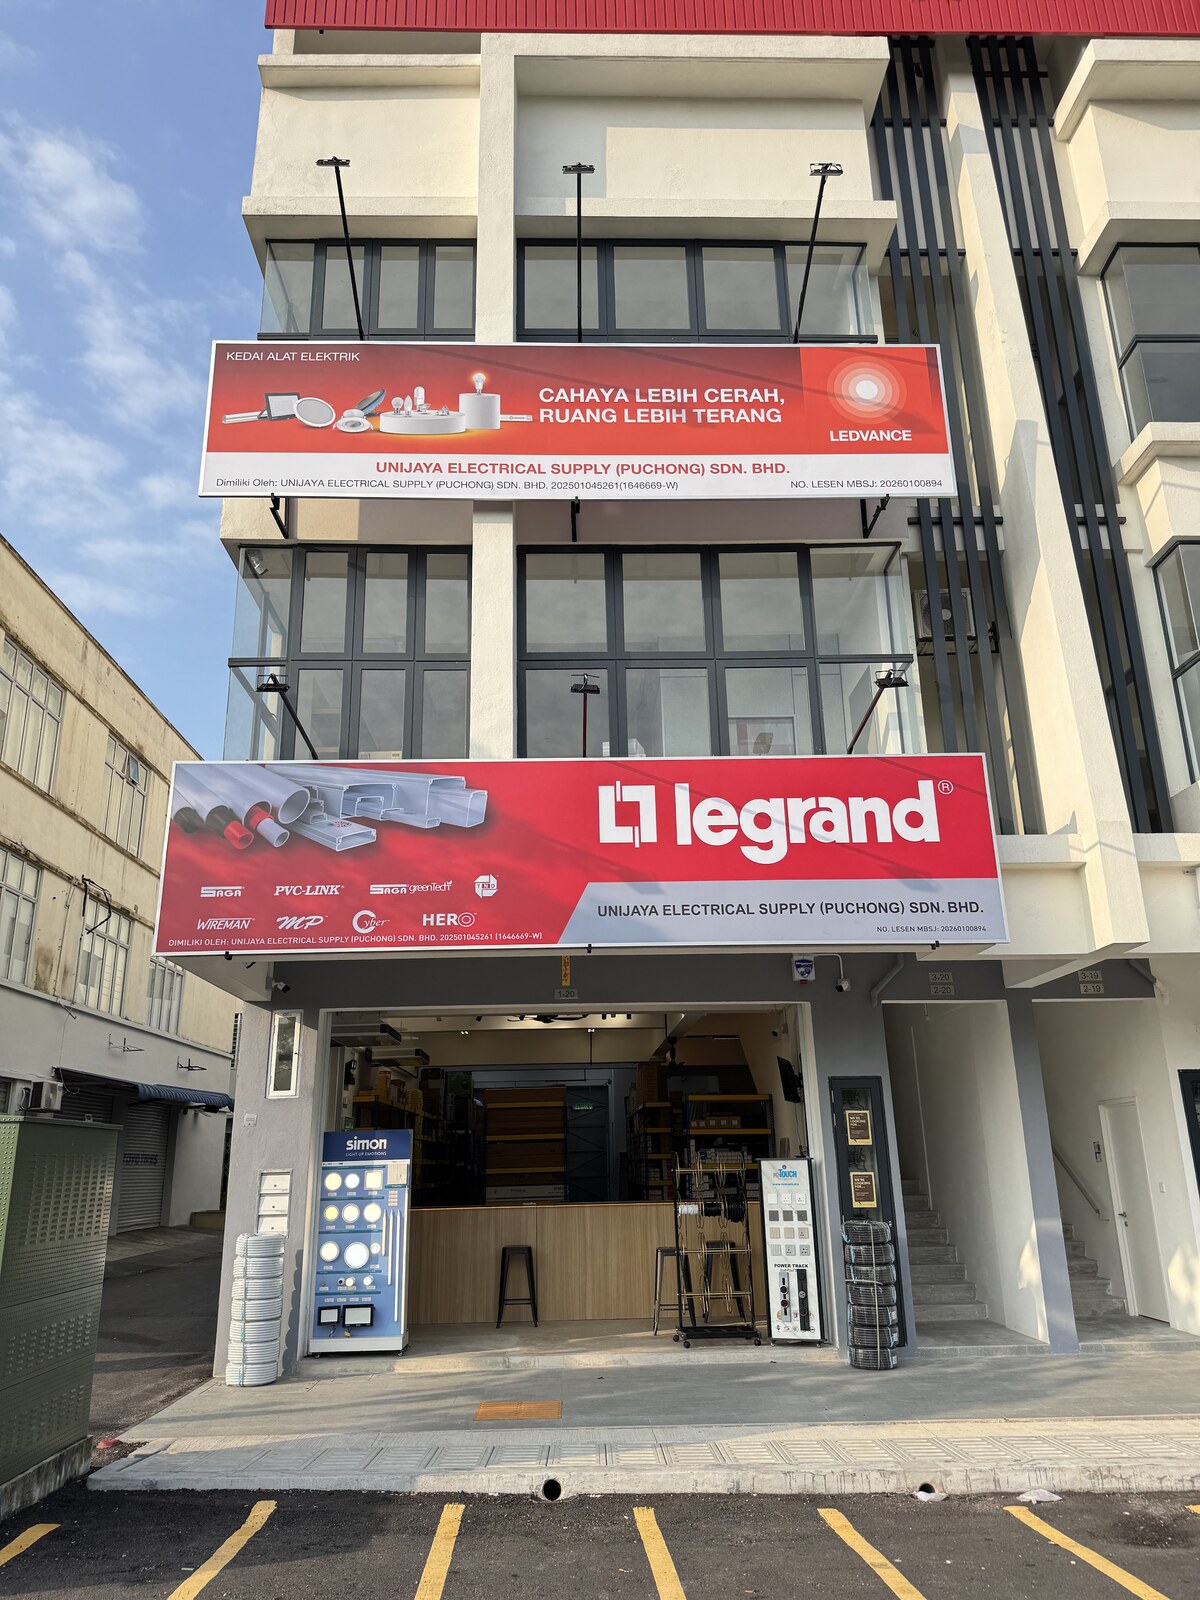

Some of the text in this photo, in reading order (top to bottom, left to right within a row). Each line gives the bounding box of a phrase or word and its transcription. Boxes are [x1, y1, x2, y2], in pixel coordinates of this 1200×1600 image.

[226, 352, 360, 361] KEDAI ALAT ELEKTRIK
[538, 388, 785, 405] CAHAYA LEBIH CERAH,
[539, 408, 782, 423] RUANG LEBIH TERANG
[829, 430, 912, 442] LEDVANCE
[376, 462, 790, 476] UNIJAYA ELECTRICAL SUPPLY (PUCHONG) SDN. BHD.
[216, 478, 679, 491] Dimiliki Oleh: UNIJAYA ELECTRICAL SUPPLY (PUCHONG) SDN. BHD. 202501045261(1646669-W)
[790, 479, 942, 488] NO. LESEN MBSJ: 20260100894
[674, 780, 940, 865] legrand
[200, 885, 242, 897] SAGA
[274, 885, 341, 896] PVC-LINK
[370, 884, 407, 894] SAGA
[597, 901, 984, 917] UNIJAYA ELECTRICAL SUPPLY (PUCHONG) SDN. BHD.
[196, 917, 252, 930] WIREMAN
[352, 909, 386, 934] Cyber
[422, 911, 475, 928] HERO
[168, 939, 203, 947] DIMILIKI
[204, 938, 229, 946] OLEH:
[267, 937, 316, 945] ELECTRICAL
[318, 936, 350, 944] SUPPLY
[350, 935, 396, 943] (PUCHONG)
[418, 934, 438, 942] BHD.
[440, 933, 493, 941] 202501045261
[495, 932, 543, 941] (1646669-W)
[931, 973, 950, 981] 3-20
[1081, 971, 1099, 980] 3-19
[558, 990, 575, 998] 1-20
[933, 986, 952, 994] 2-20
[1083, 984, 1101, 993] 2-19
[346, 1135, 388, 1151] simon
